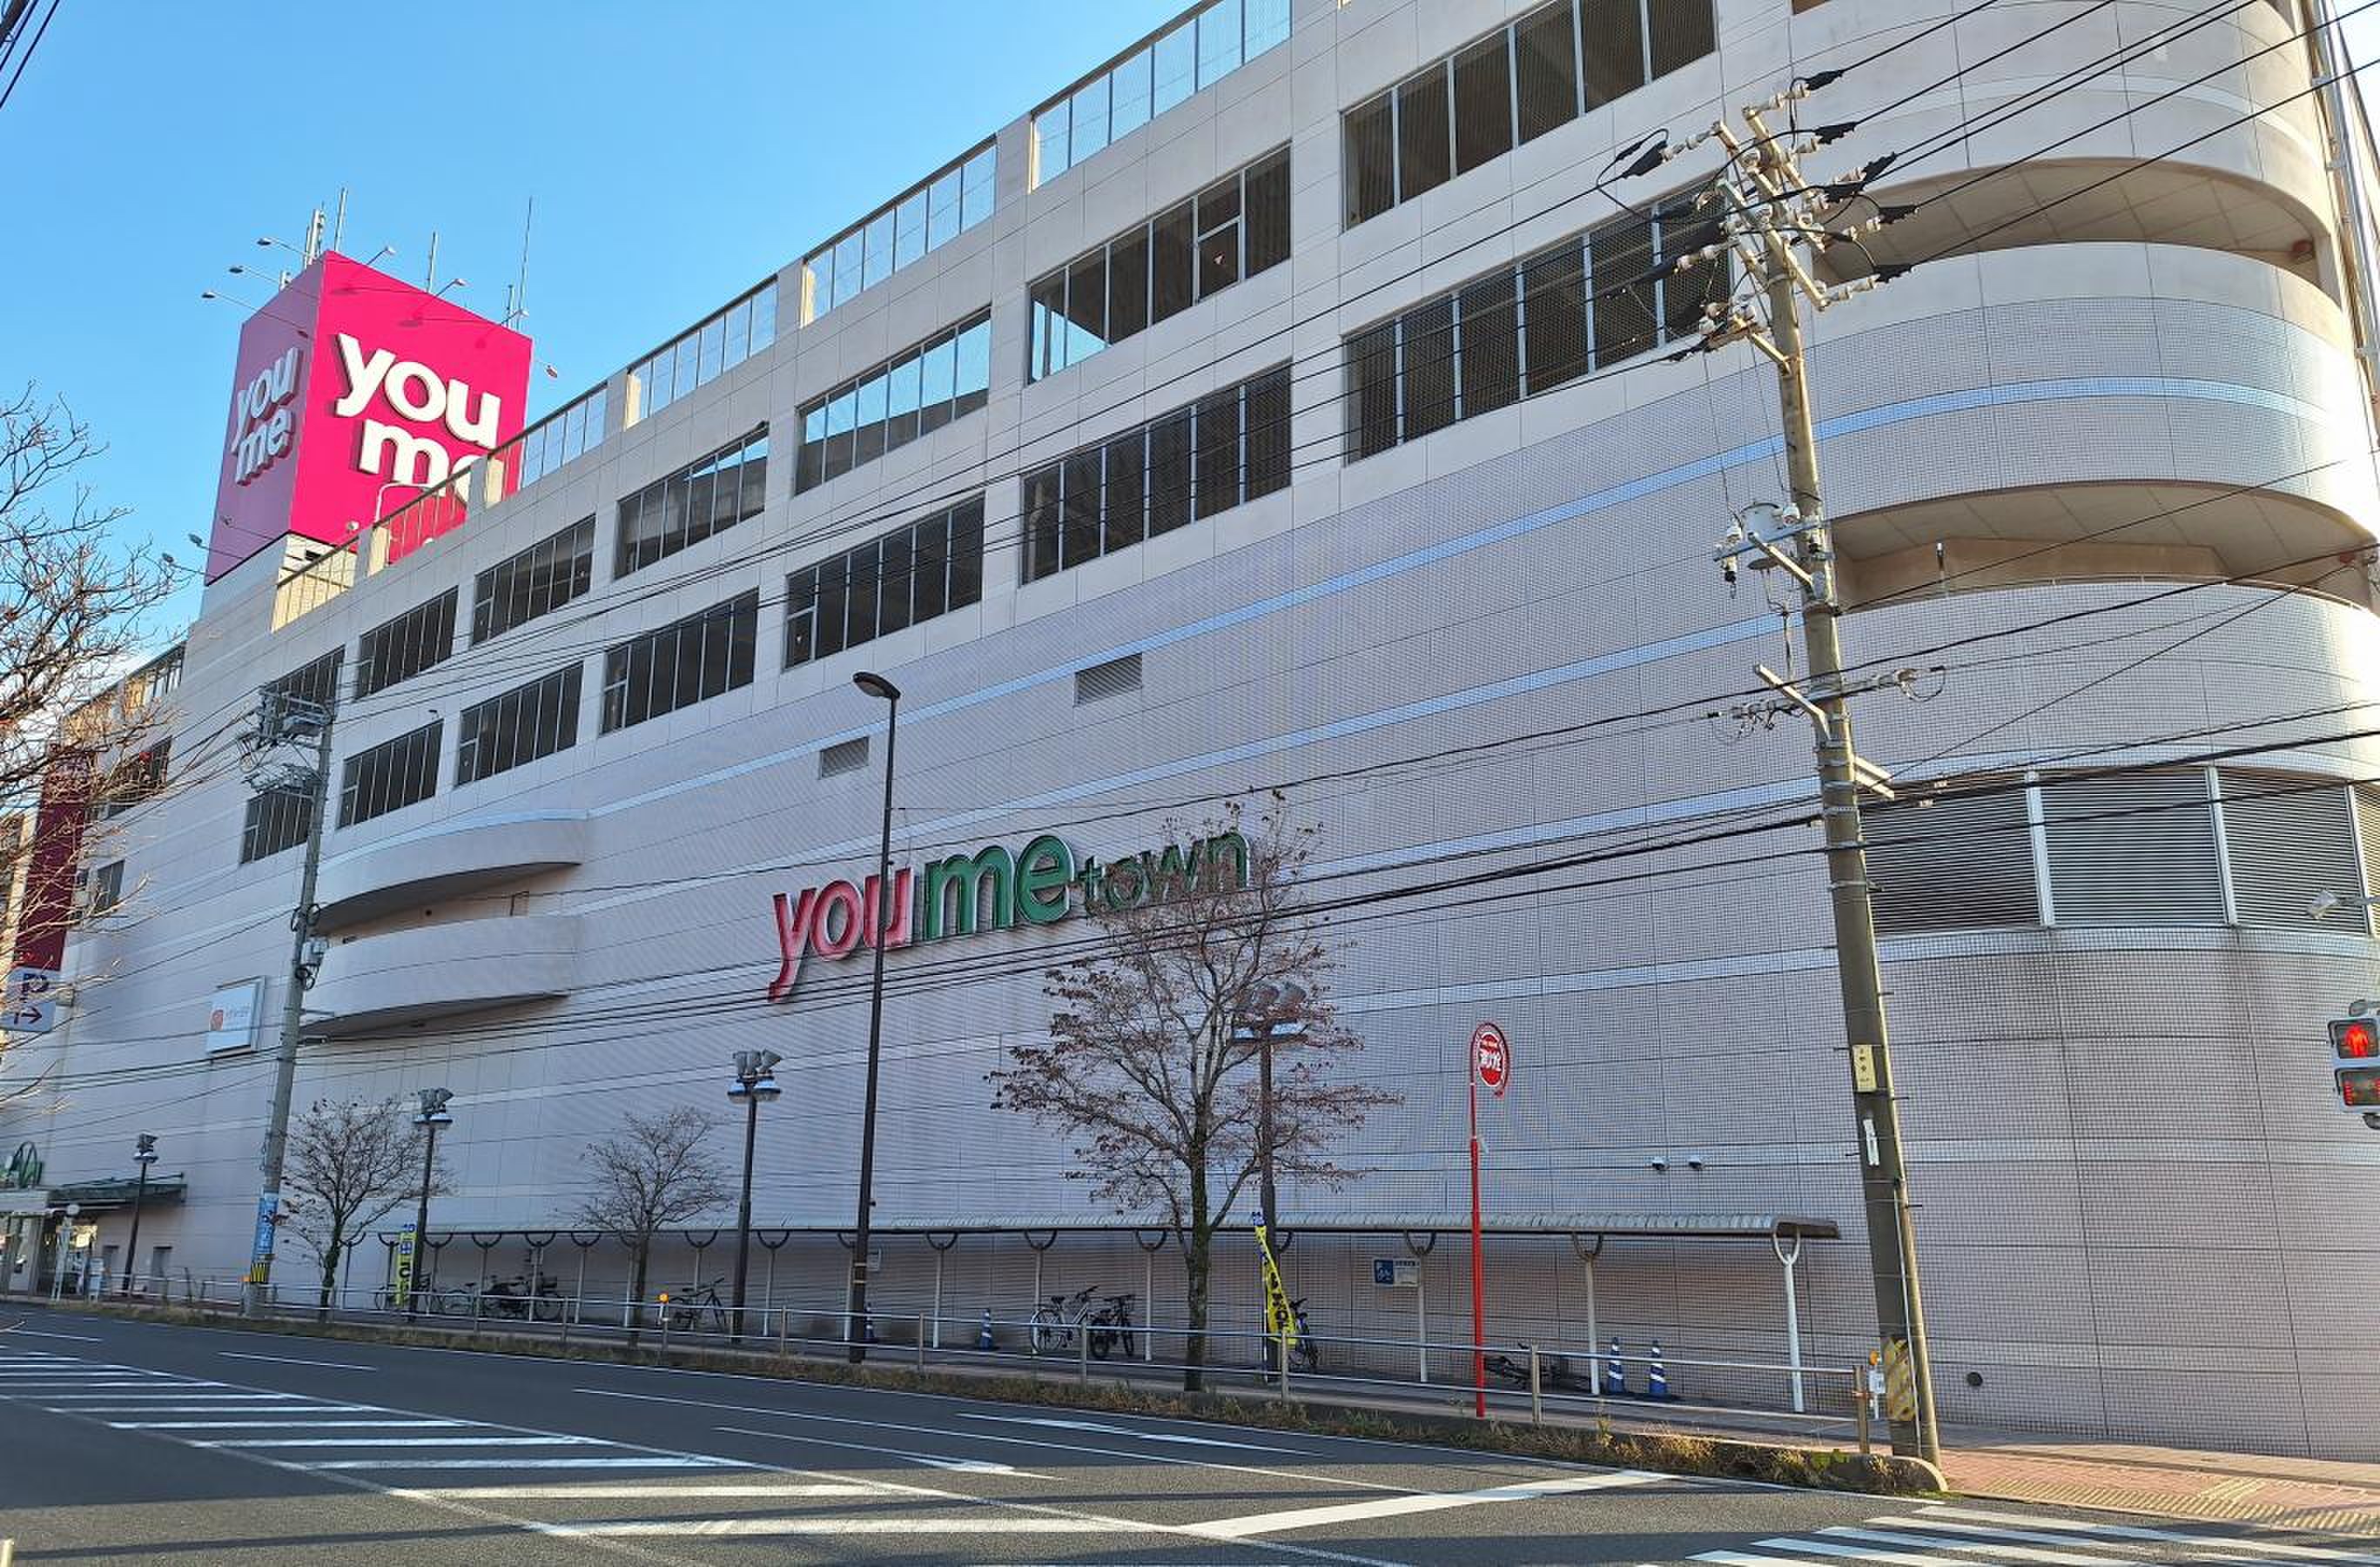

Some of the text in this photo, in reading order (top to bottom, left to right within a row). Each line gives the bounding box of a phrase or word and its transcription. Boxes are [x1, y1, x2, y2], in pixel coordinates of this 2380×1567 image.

[231, 347, 302, 454] you
[336, 333, 501, 447] you
[235, 407, 296, 486] me
